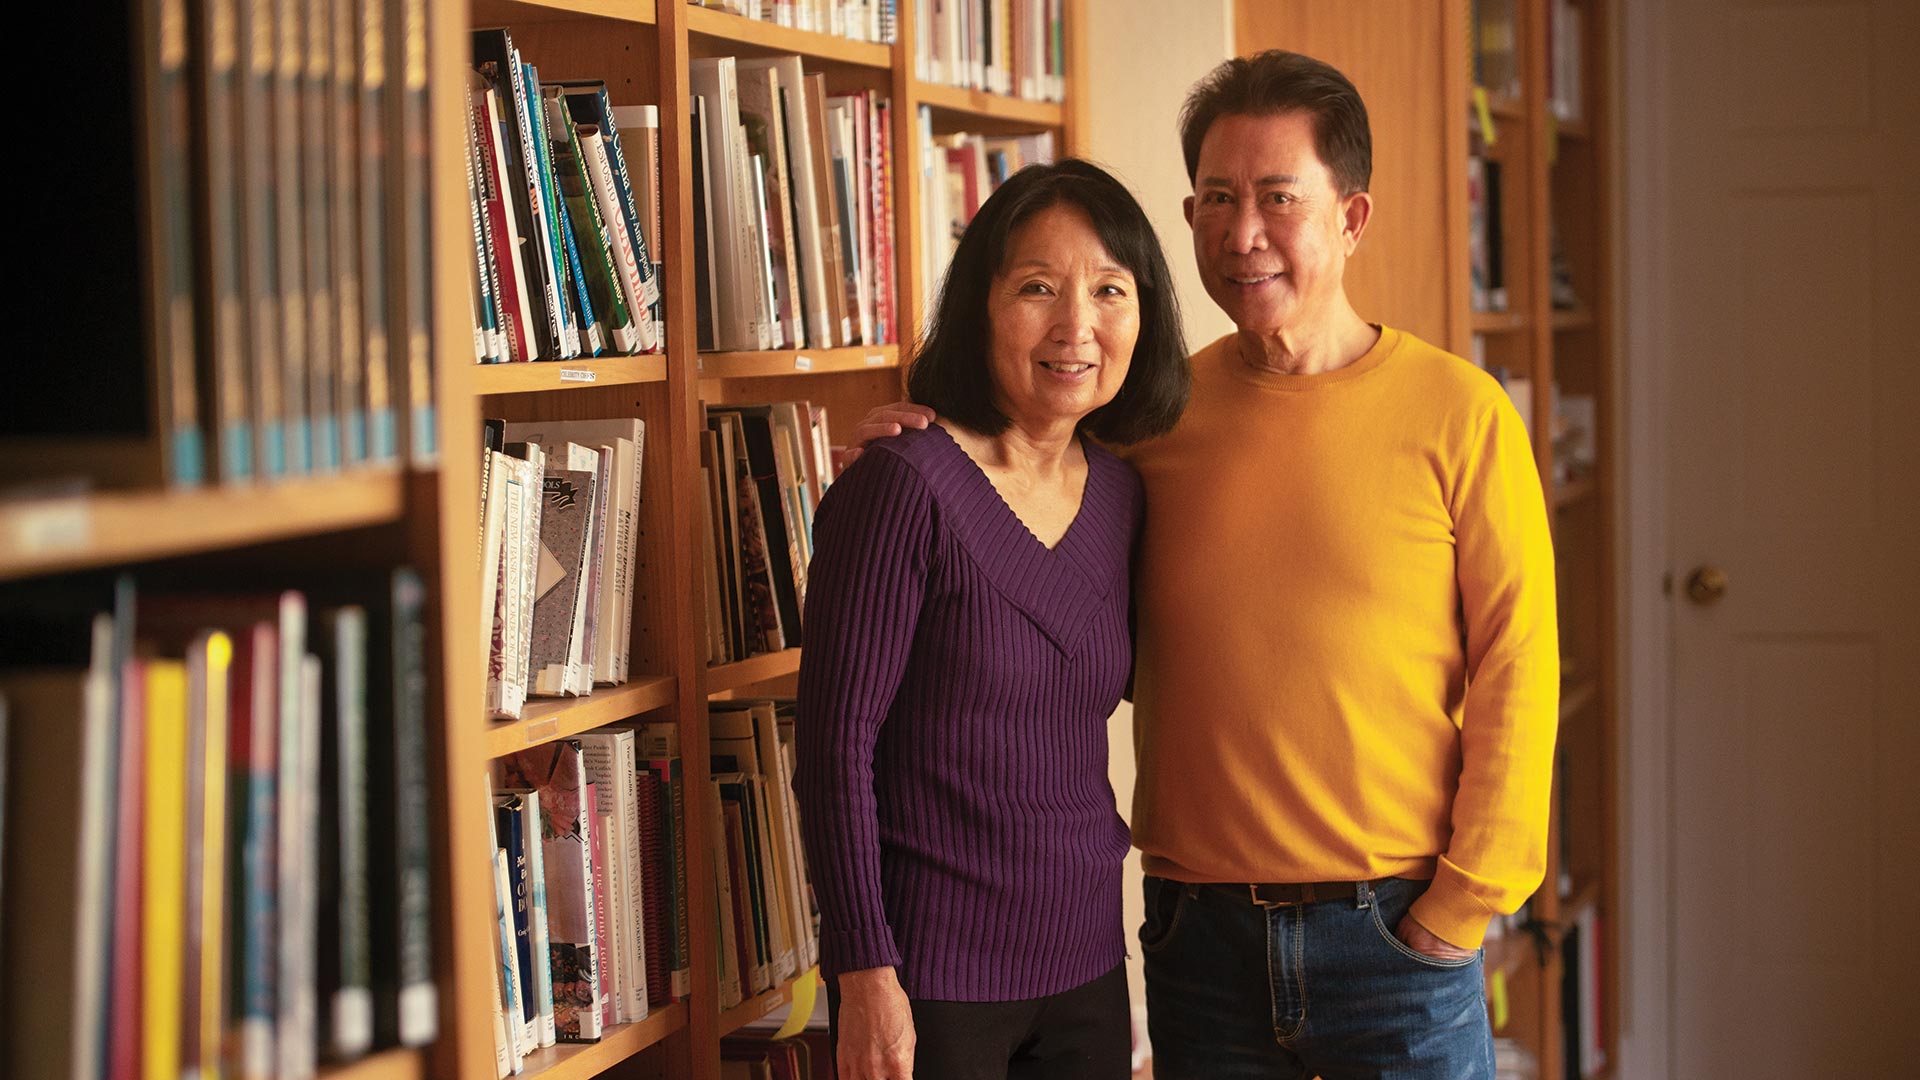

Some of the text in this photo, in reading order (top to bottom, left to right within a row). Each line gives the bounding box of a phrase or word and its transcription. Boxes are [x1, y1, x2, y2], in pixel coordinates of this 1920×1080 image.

[529, 186, 539, 215] KOI
[543, 97, 552, 140] COOKING
[558, 210, 567, 248] BRIDGET
[563, 248, 572, 282] JONES
[596, 144, 616, 202] ESPOSITO
[614, 207, 636, 268] CIAO
[602, 91, 616, 134] Nella
[613, 133, 631, 191] Cucina
[626, 191, 638, 221] Mary
[633, 222, 643, 244] Ann
[638, 244, 652, 281] Esposit
[569, 234, 579, 265] MEALS
[590, 192, 602, 228] COOKS
[599, 228, 609, 251] WITH
[605, 251, 613, 267] HIS
[609, 266, 624, 305] FRIENDS
[481, 446, 491, 499] COOKING
[636, 429, 644, 473] Nathalie
[508, 490, 519, 513] THE
[633, 479, 641, 527] Dupree's
[508, 514, 519, 543] NEW
[615, 508, 625, 550] MATTERS
[508, 544, 518, 584] BASICS
[615, 551, 623, 565] OF
[621, 510, 632, 597] NATHALIE DUPREE'S
[508, 586, 518, 651] COOKBOOK
[626, 801, 636, 859] BRAND
[583, 839, 591, 870] BEST
[673, 783, 689, 965] THE UNCOMMON GOURMET
[585, 877, 592, 893] OF
[629, 862, 640, 906] NAME
[587, 900, 595, 944] MENUS
[597, 892, 606, 943] Family
[633, 908, 642, 962] COOKBOOK
[590, 951, 599, 992] TODAY
[600, 948, 608, 981] Table
